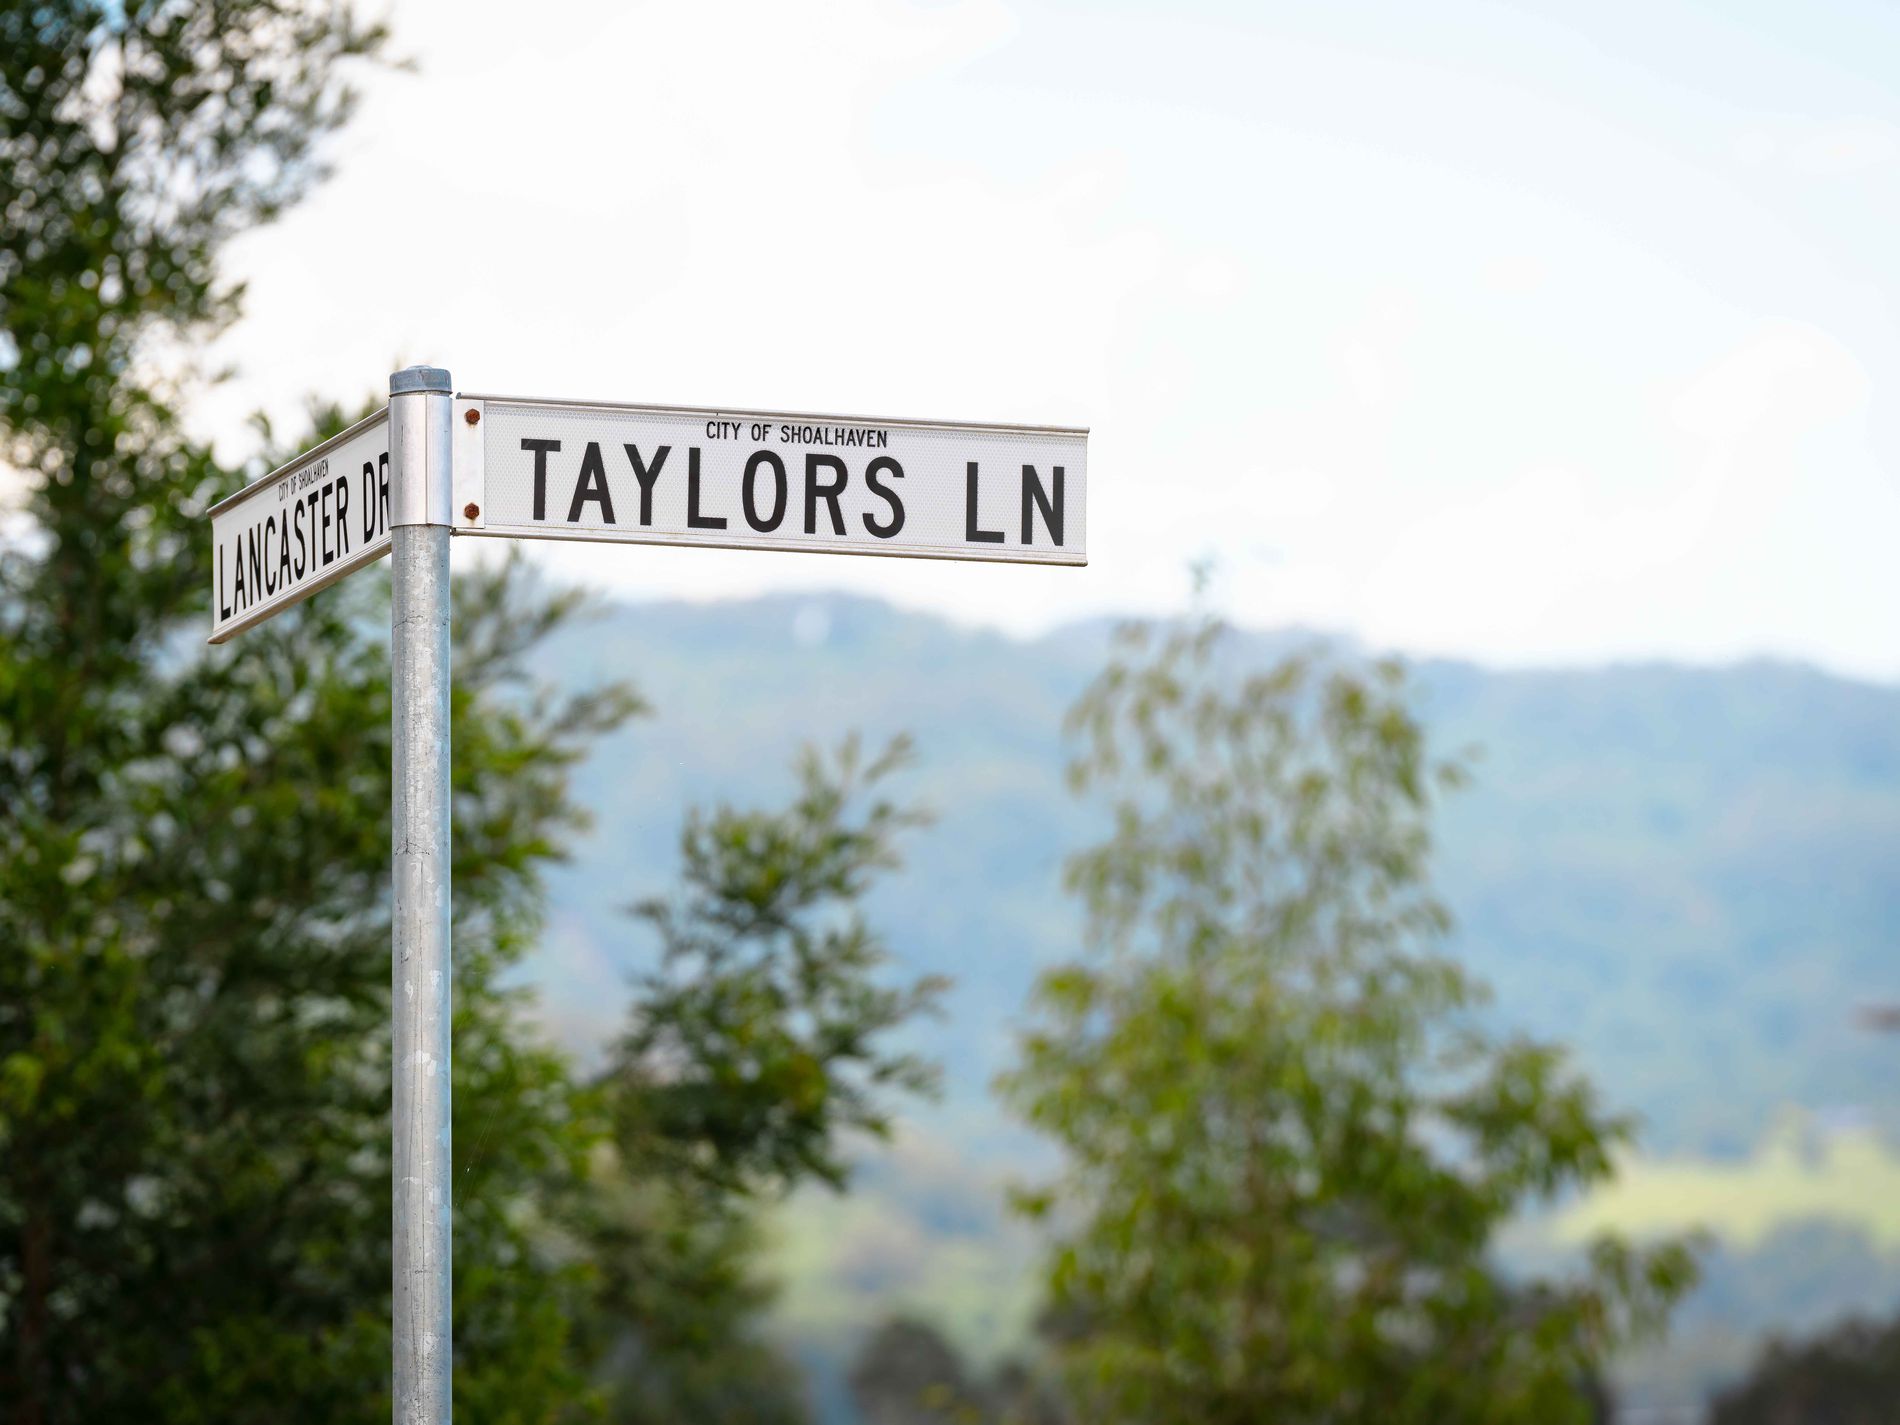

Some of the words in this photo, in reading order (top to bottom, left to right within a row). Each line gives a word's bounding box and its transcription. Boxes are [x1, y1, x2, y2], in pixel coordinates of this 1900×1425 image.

[706, 420, 741, 440] CITY
[750, 423, 771, 442] OF
[780, 425, 887, 448] SHOALHAVEN
[278, 482, 289, 502] CITY
[290, 475, 297, 496] OF
[298, 458, 329, 491] SHOALHAVEN
[520, 438, 905, 538] TAYLORS
[966, 461, 1065, 546] LN
[220, 475, 350, 622] LANCASTER
